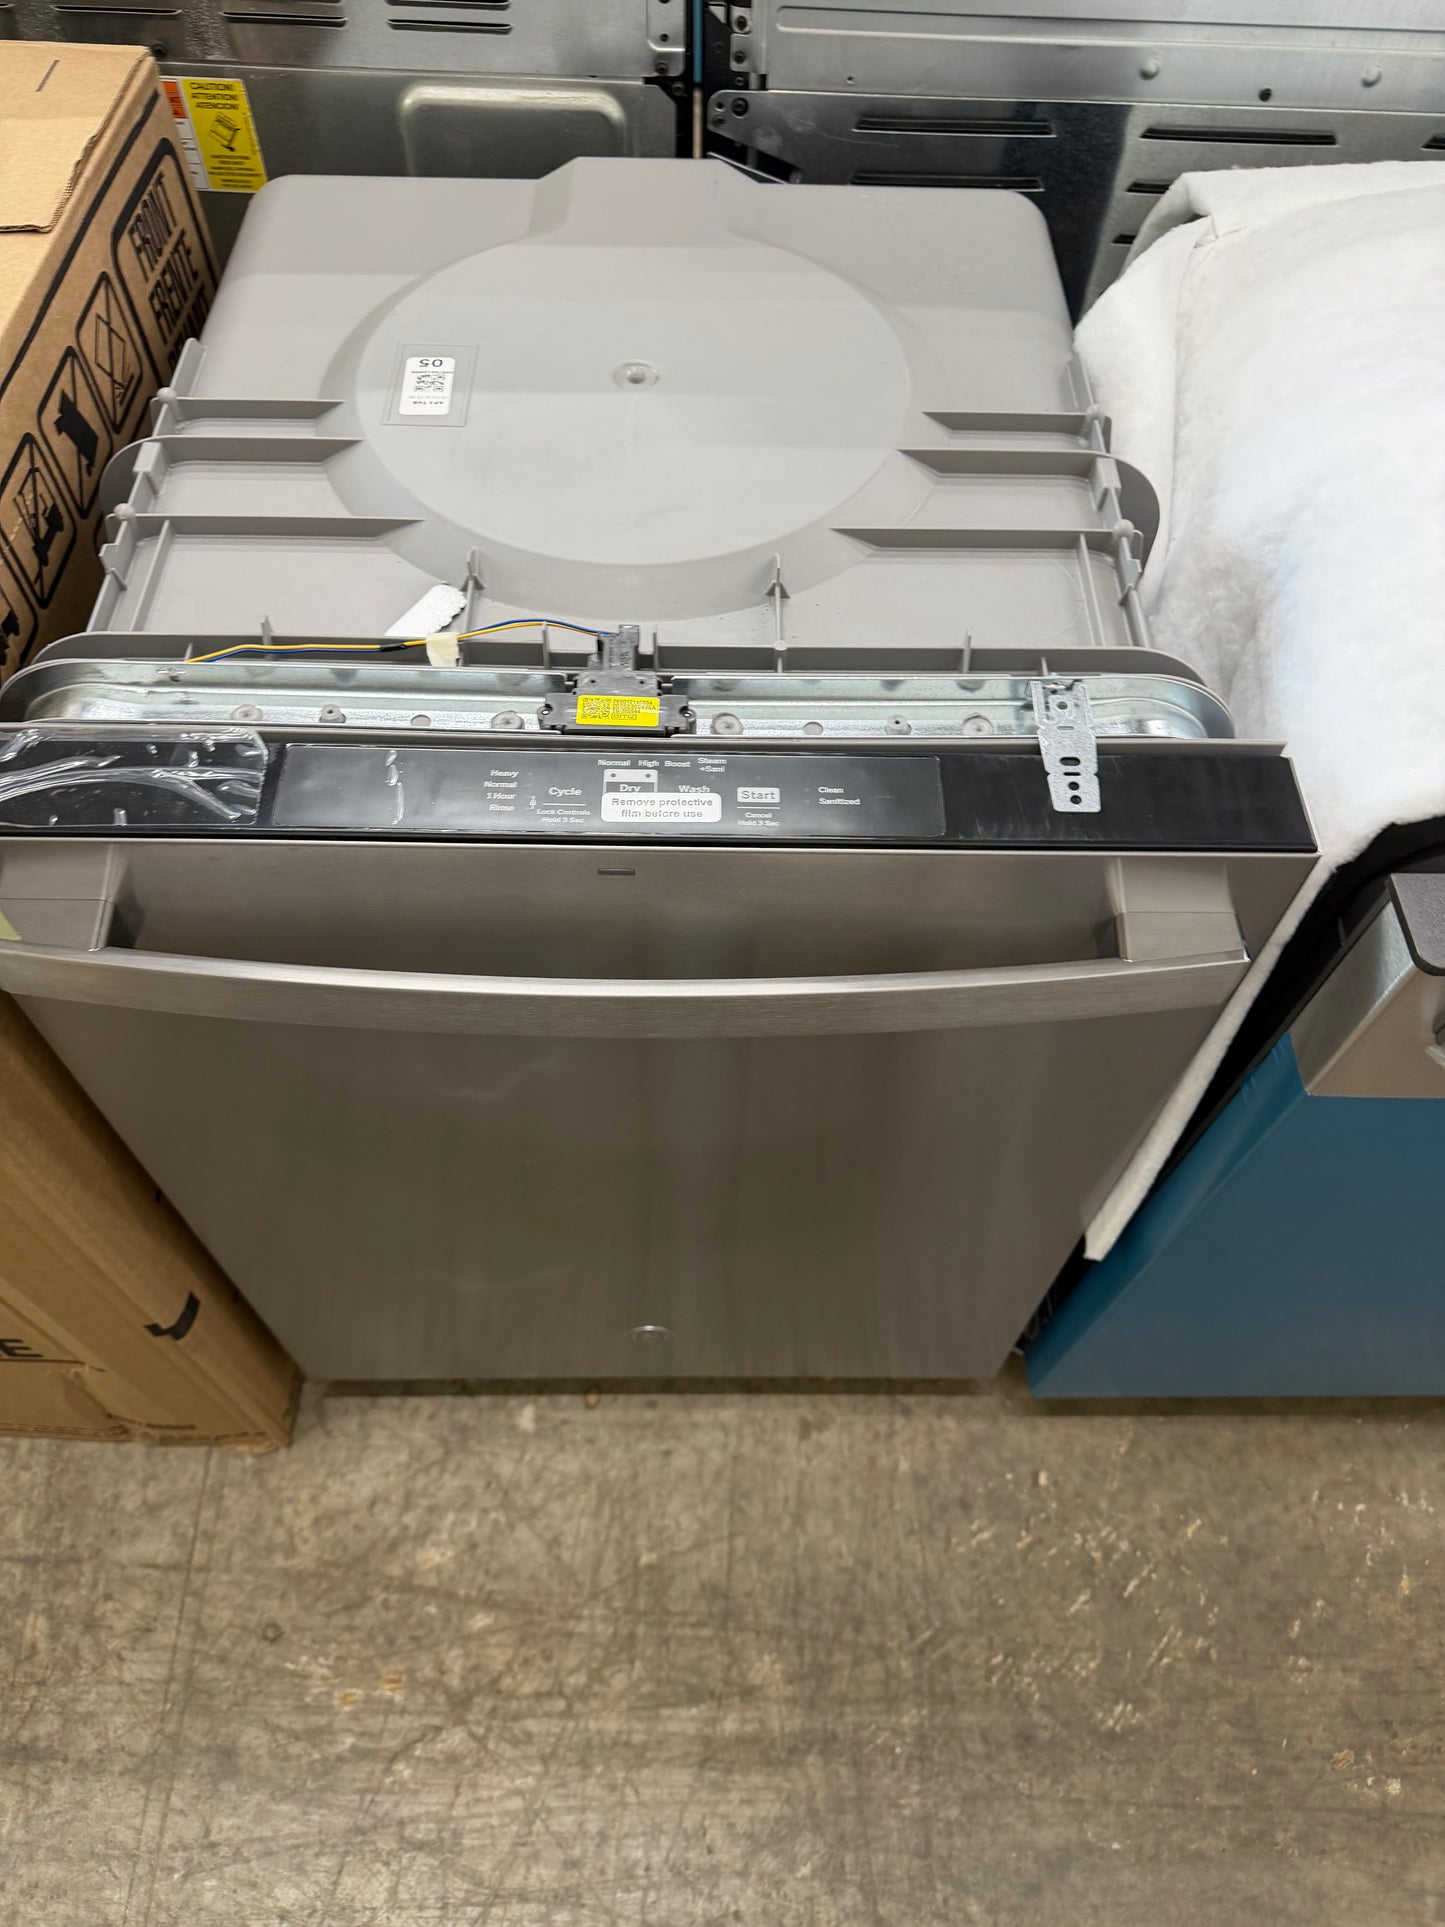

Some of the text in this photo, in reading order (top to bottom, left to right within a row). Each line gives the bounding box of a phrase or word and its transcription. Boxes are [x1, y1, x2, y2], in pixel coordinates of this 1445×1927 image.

[128, 171, 177, 283] FRONT
[148, 227, 199, 347] FRENTE
[419, 359, 443, 368] 05
[638, 760, 660, 768] High
[697, 757, 727, 765] Steam
[490, 769, 519, 778] Heavy
[548, 787, 582, 797] Cycle
[619, 784, 710, 793] Dry Wash
[818, 786, 844, 794] Clean
[741, 790, 777, 800] Start
[611, 798, 713, 808] Remove protective
[621, 809, 703, 818] film before use
